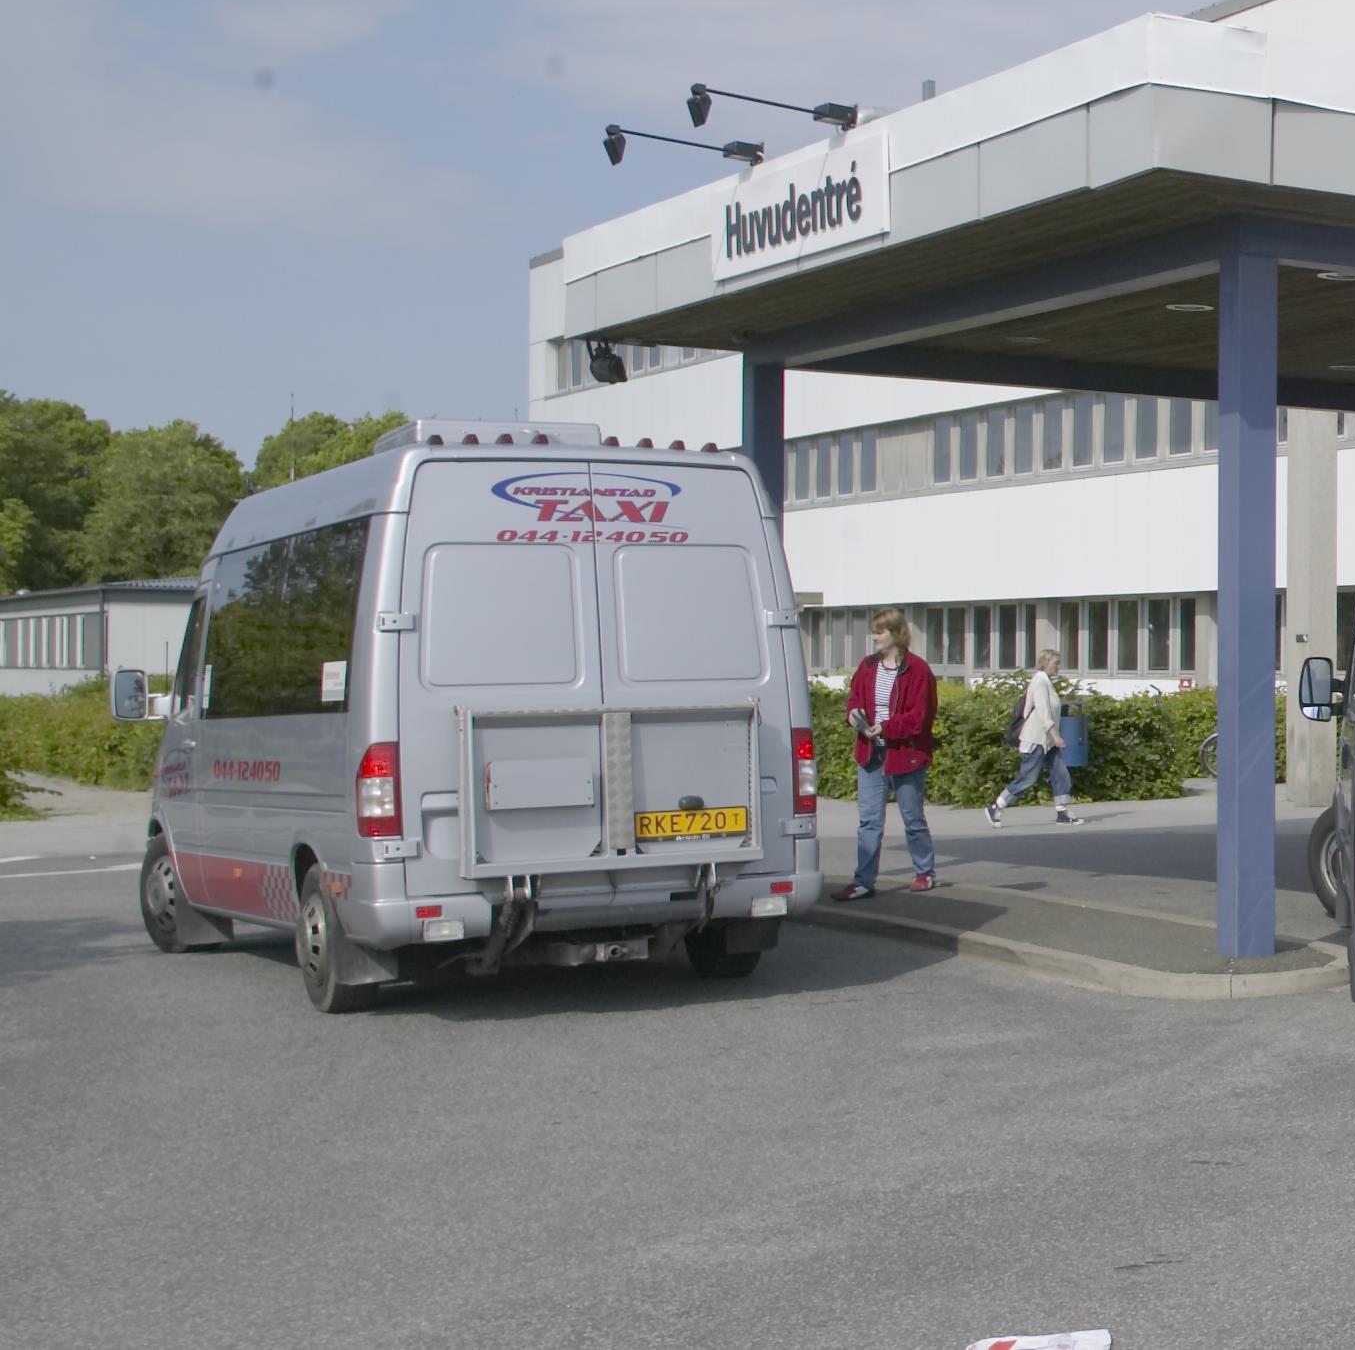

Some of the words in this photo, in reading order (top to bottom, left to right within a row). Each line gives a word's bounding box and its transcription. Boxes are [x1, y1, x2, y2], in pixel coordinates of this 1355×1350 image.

[725, 160, 863, 260] Huvudentré
[512, 486, 657, 498] KRISTIANSTAD
[533, 499, 670, 523] TAXI
[639, 811, 727, 835] RKE720
[732, 813, 740, 826] T
